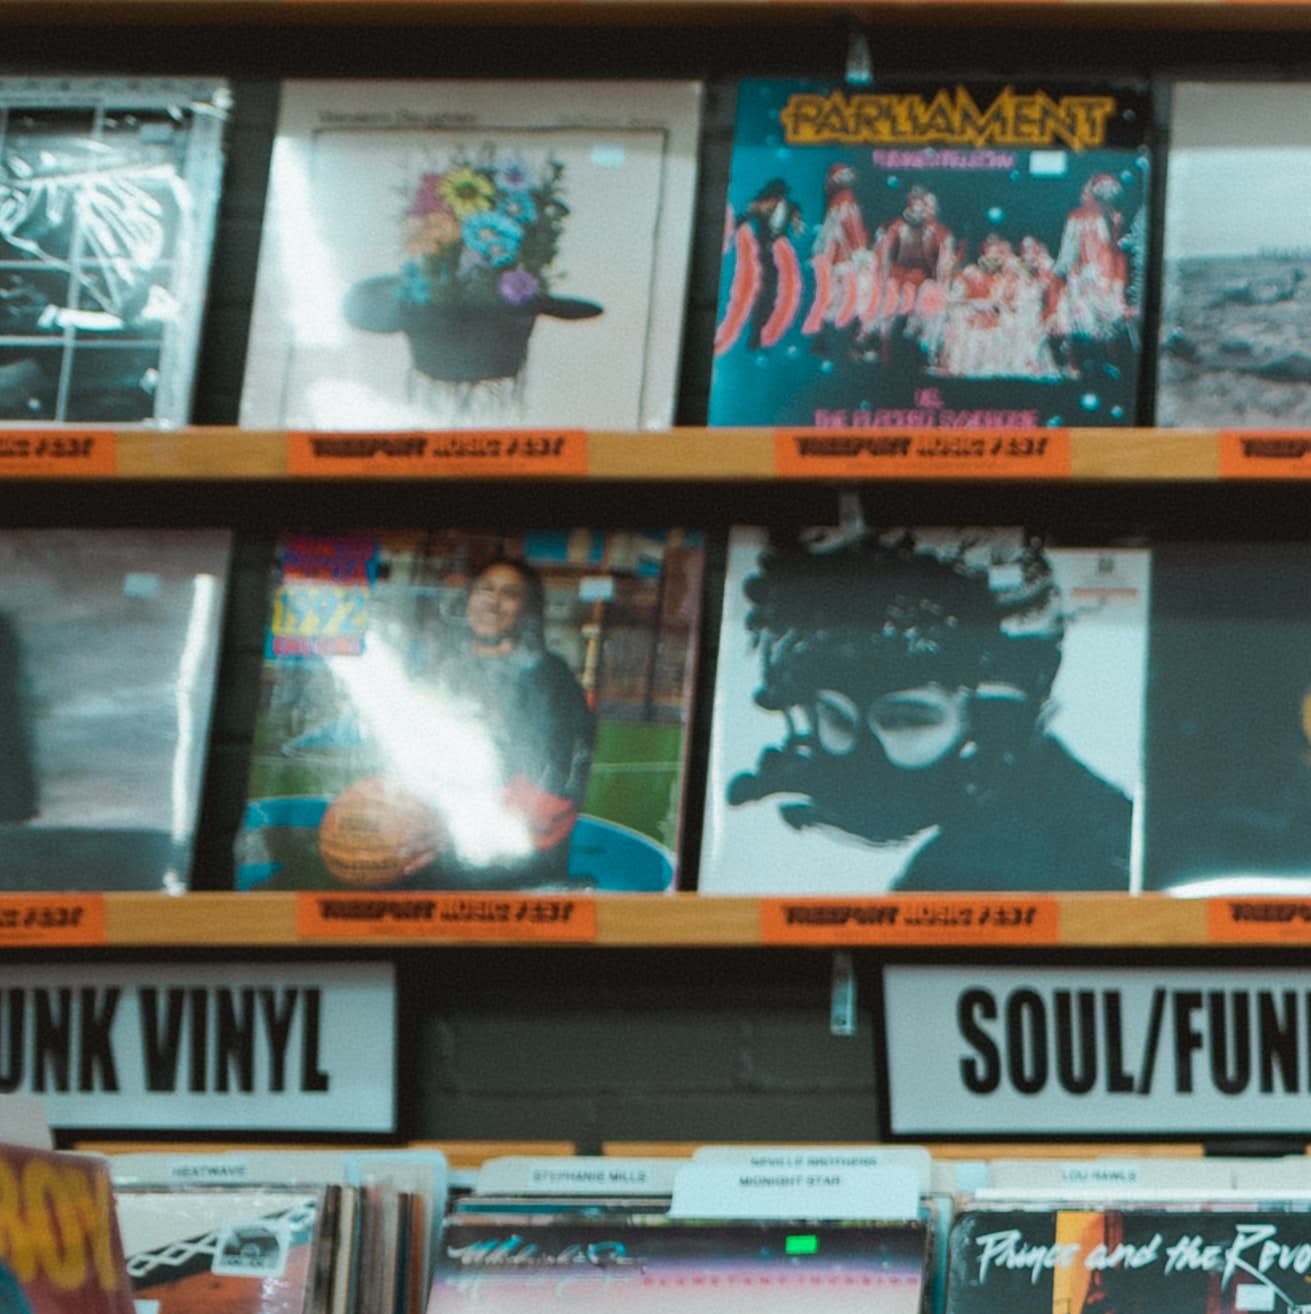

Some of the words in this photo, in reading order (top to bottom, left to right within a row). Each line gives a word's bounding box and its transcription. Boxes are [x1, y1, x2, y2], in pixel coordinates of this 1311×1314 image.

[139, 985, 330, 1093] VINYL
[975, 1228, 1080, 1285] Prince
[1084, 1233, 1163, 1269] and
[1163, 1235, 1228, 1276] the
